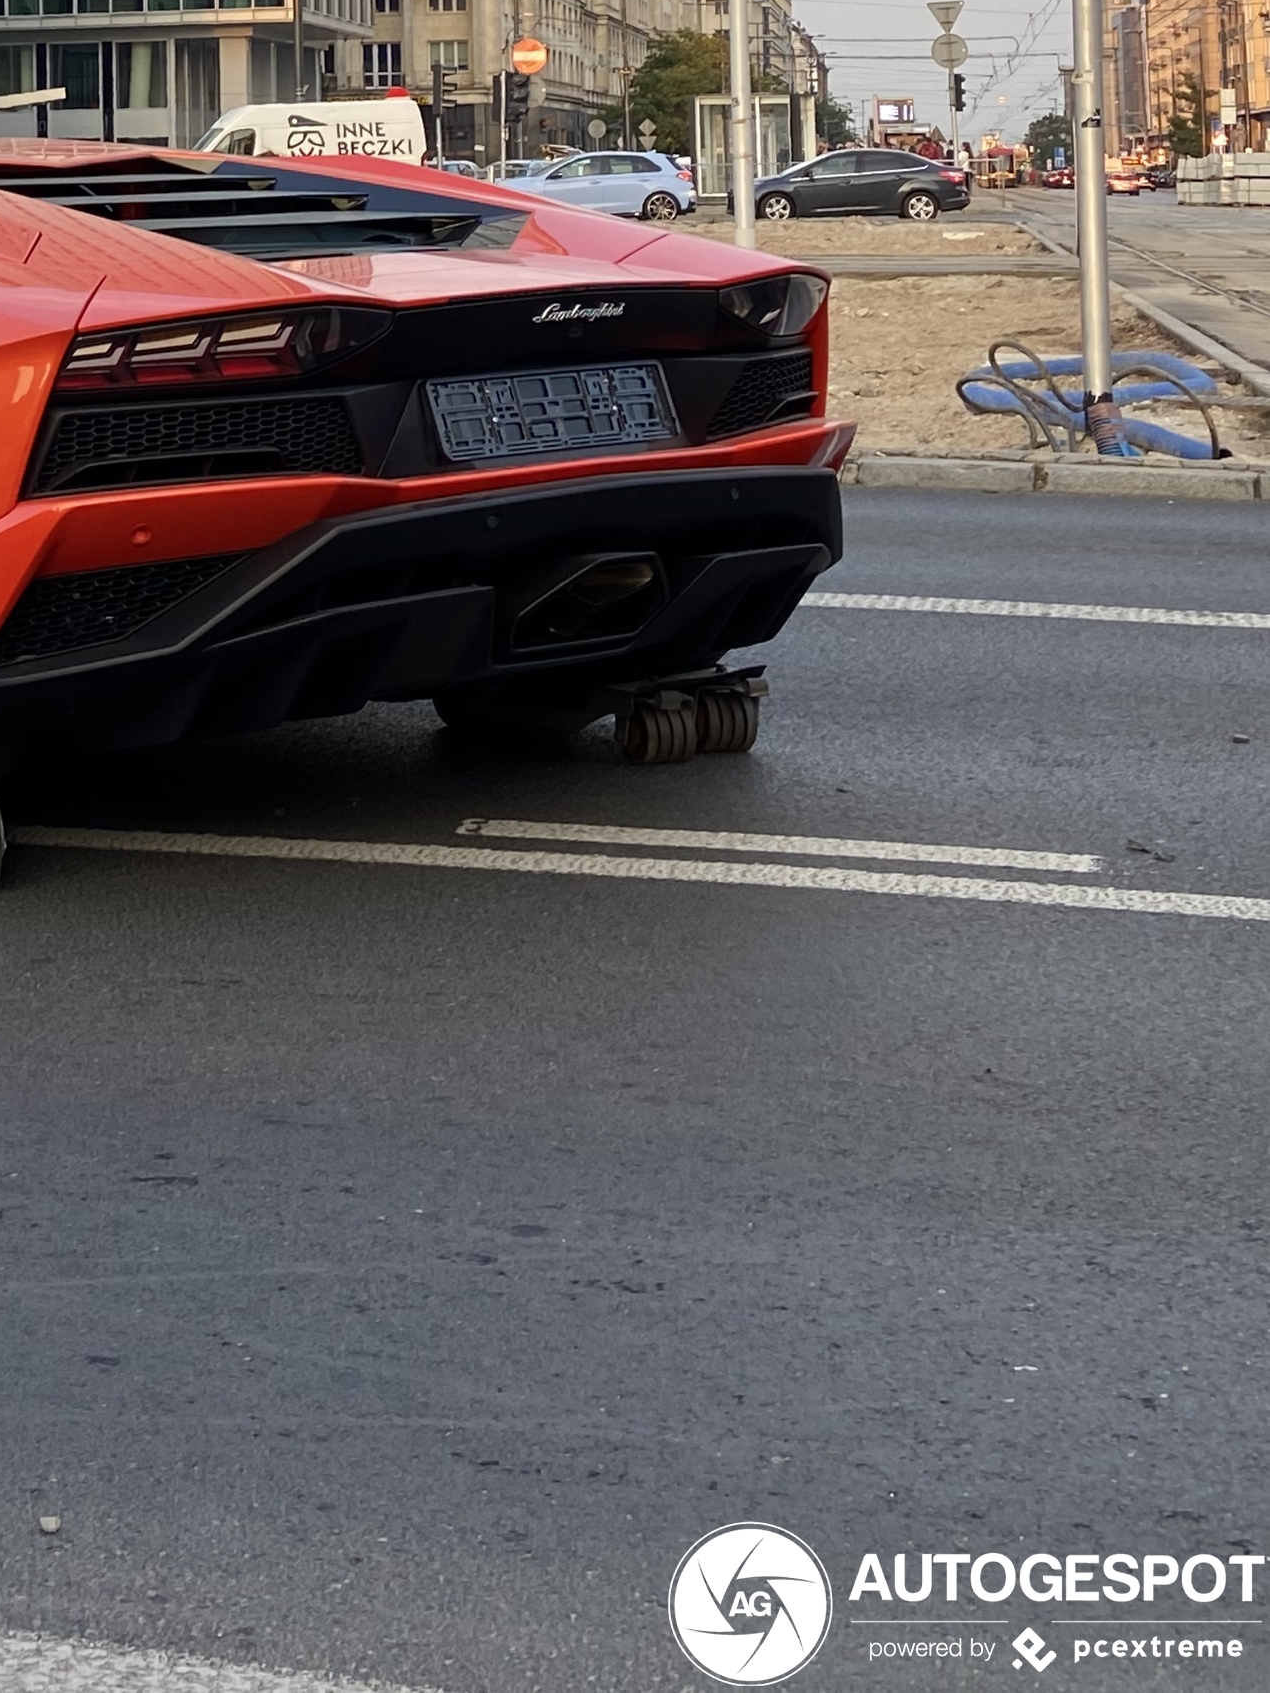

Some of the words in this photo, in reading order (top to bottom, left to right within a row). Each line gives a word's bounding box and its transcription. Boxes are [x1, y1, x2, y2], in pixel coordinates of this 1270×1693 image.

[336, 121, 386, 139] INNE
[337, 139, 413, 156] BECZKI
[532, 302, 626, 324] Lamborghini
